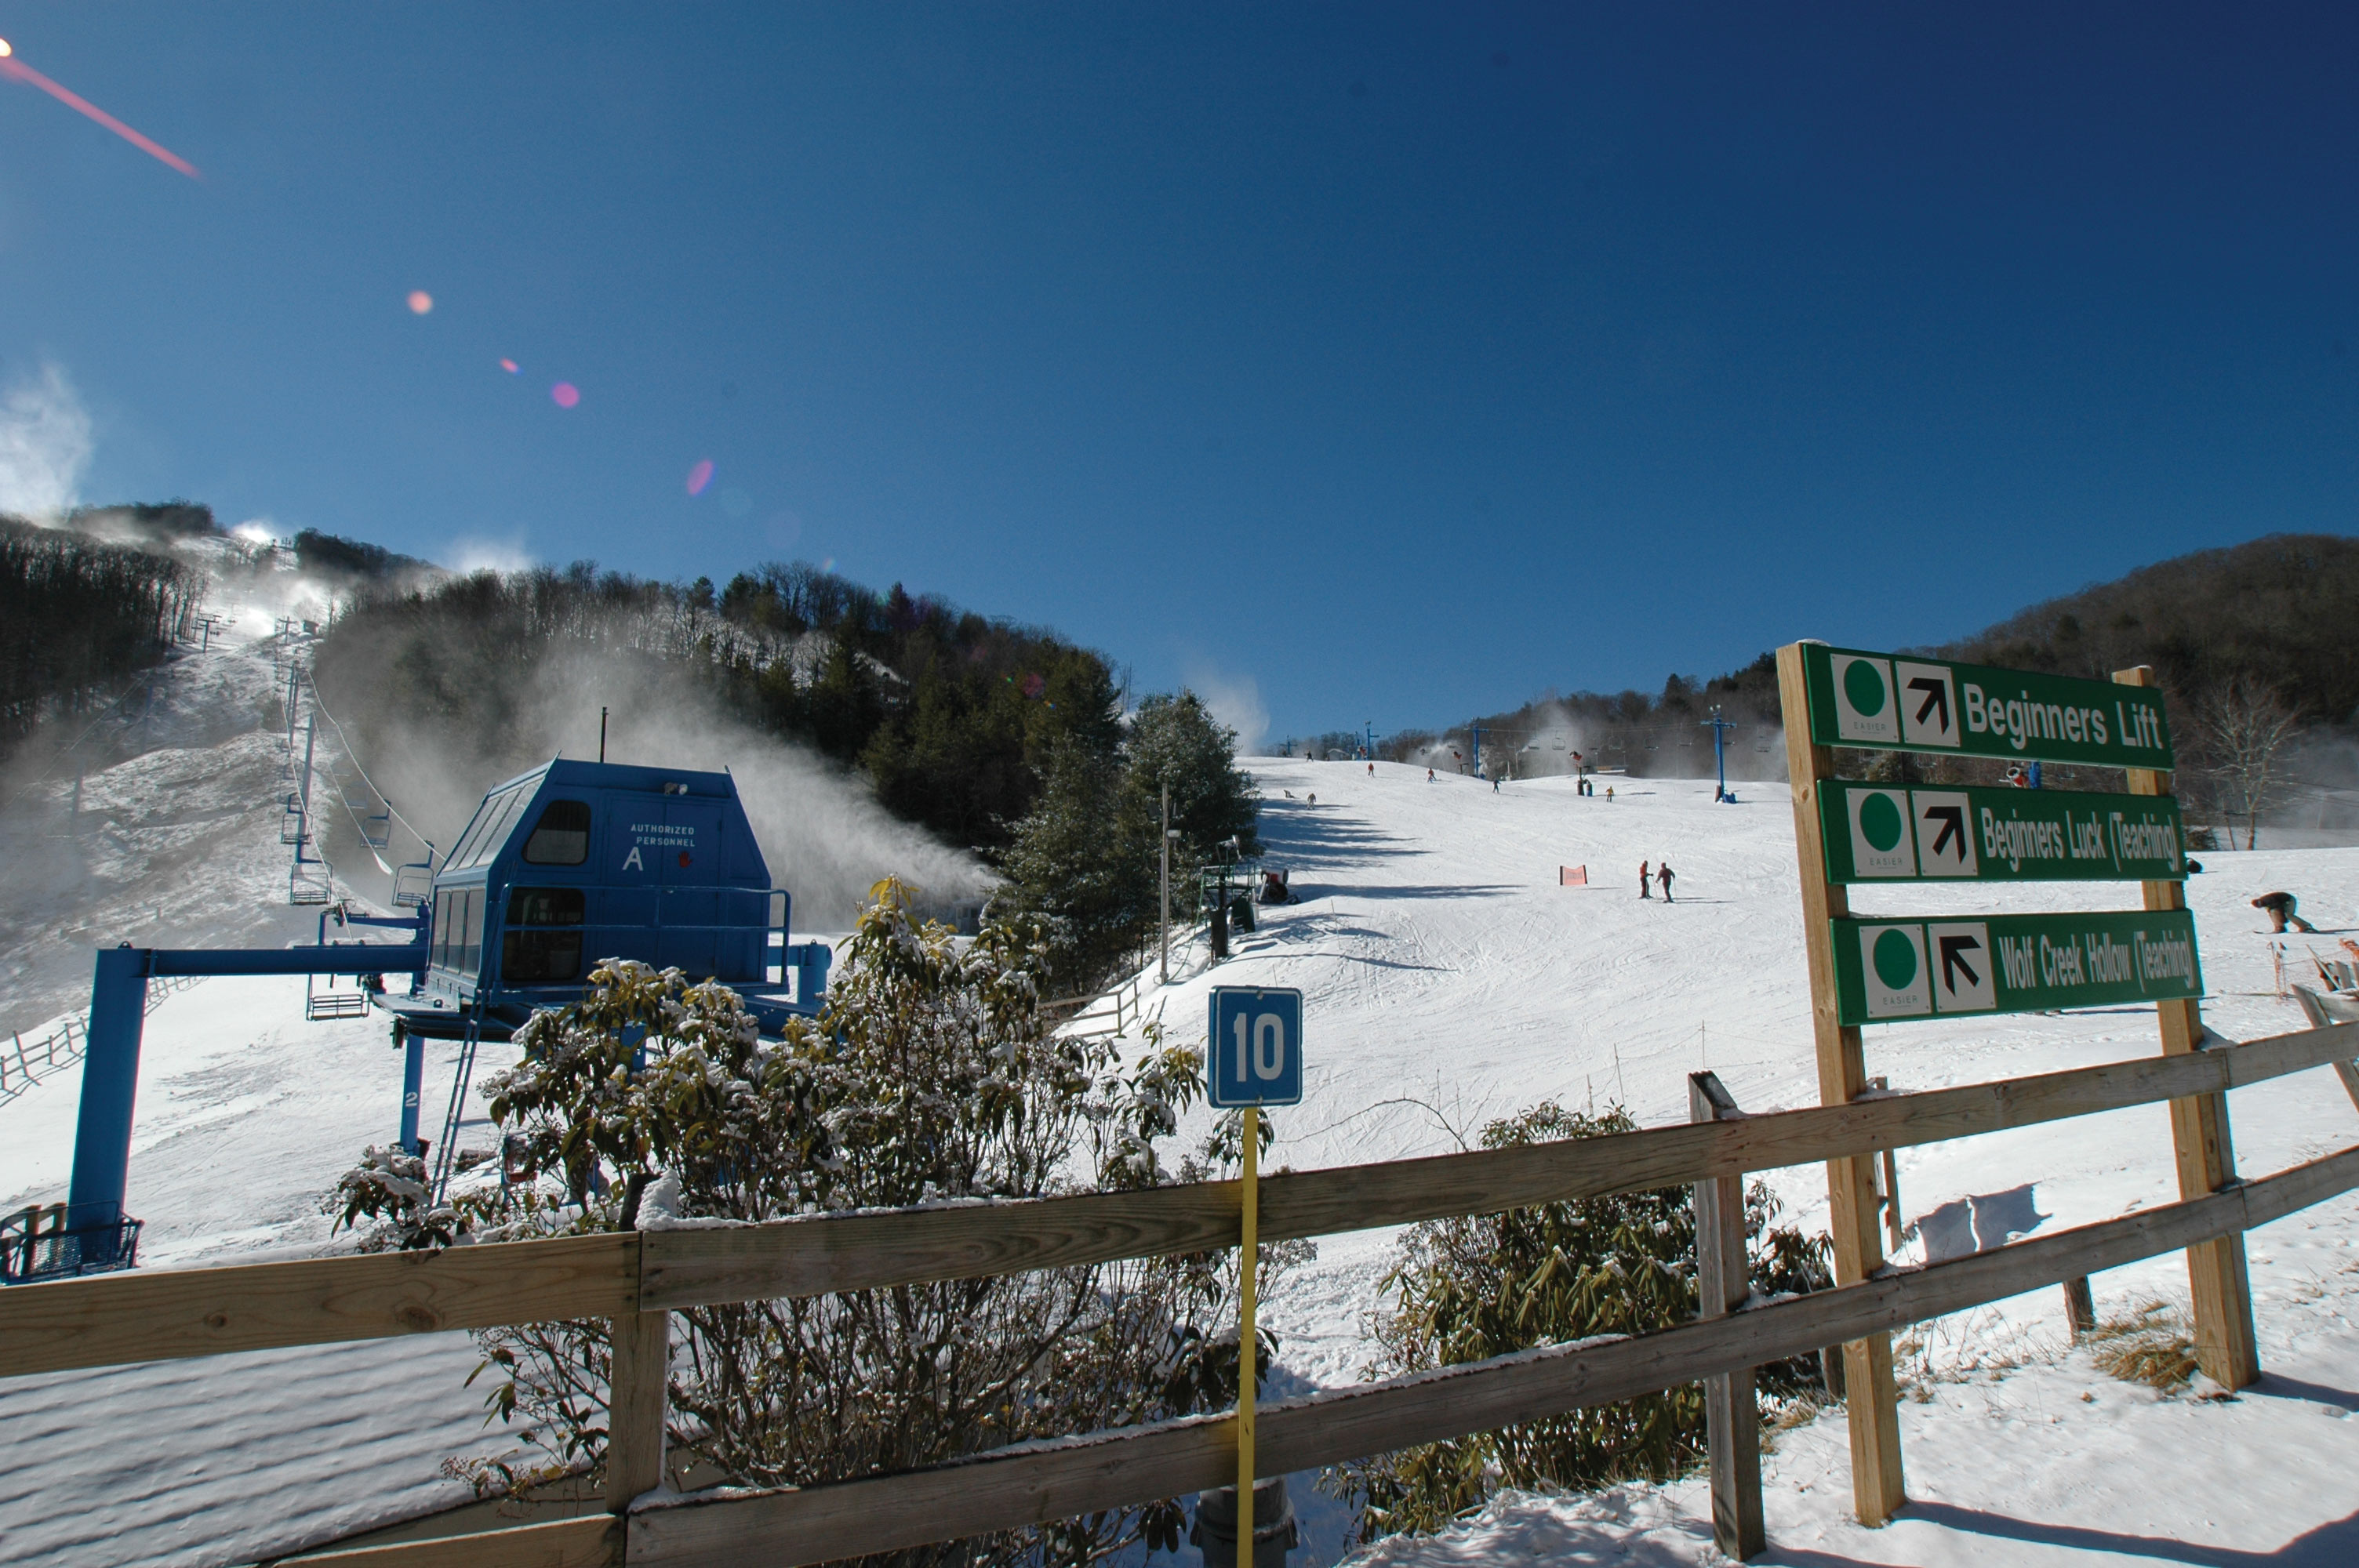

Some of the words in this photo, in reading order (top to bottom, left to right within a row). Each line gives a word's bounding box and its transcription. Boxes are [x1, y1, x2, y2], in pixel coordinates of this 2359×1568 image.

[1963, 683, 2108, 750] Beginners
[2116, 701, 2163, 750] Lift
[1853, 721, 1887, 731] EASIER
[631, 823, 695, 835] AUTHORIZED
[636, 836, 696, 848] PERSONNEL
[1981, 808, 2064, 873] Beginners
[2066, 810, 2107, 859] Luck
[2109, 811, 2181, 873] (Teaching)
[622, 846, 644, 872] A
[1869, 857, 1903, 866] EASIER
[1998, 935, 2037, 989] Wolf
[2041, 934, 2085, 988] Creek
[2085, 932, 2132, 983] Hollow
[2133, 929, 2196, 993] (Teaching)
[1883, 995, 1918, 1006] EASIER
[1234, 1012, 1285, 1082] 10
[405, 1091, 419, 1108] 2
